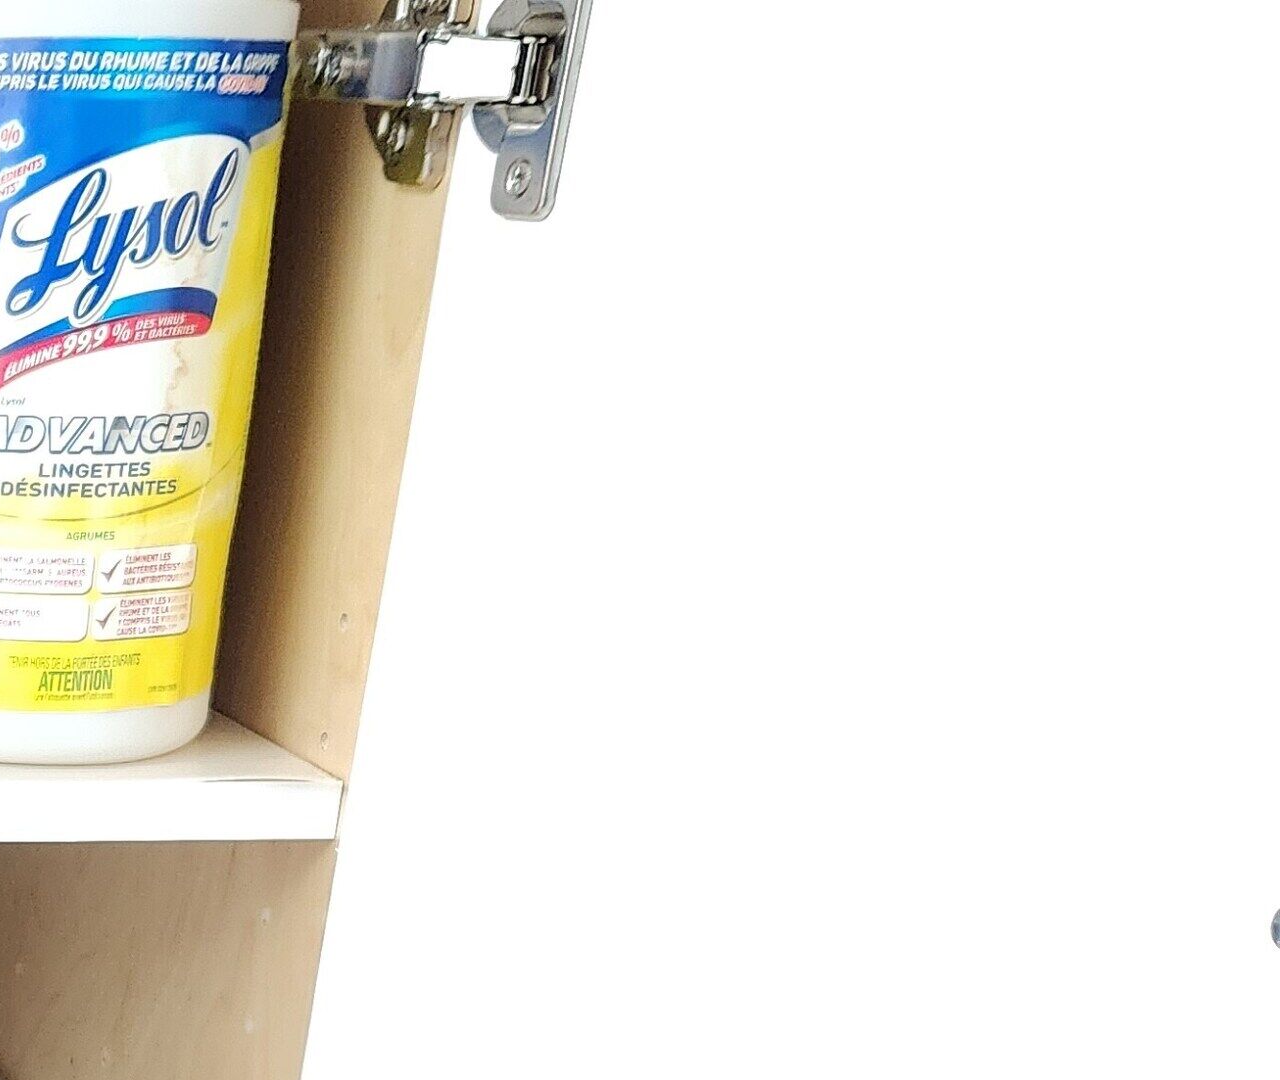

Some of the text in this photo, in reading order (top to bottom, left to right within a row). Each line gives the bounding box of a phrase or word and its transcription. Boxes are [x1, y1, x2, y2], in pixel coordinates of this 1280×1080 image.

[12, 52, 67, 72] VIRUS
[69, 51, 99, 71] DU
[100, 51, 171, 71] RHUME
[169, 51, 196, 72] ET
[194, 51, 223, 73] DE
[219, 52, 244, 73] LA
[37, 74, 62, 91] LE
[63, 74, 111, 90] VIRUS
[112, 73, 141, 91] QUI
[143, 74, 195, 92] CAUSE
[194, 74, 217, 92] LA
[6, 147, 239, 320] Lysol
[135, 314, 186, 331] DES VIRUS
[134, 331, 147, 342] ET
[38, 461, 151, 479] LINGETTES
[0, 478, 177, 498] DÉSINFECTANTES
[66, 531, 115, 541] AGRUMES
[159, 552, 172, 561] LES
[122, 578, 137, 586] AUX
[38, 669, 113, 692] ATTENTION
